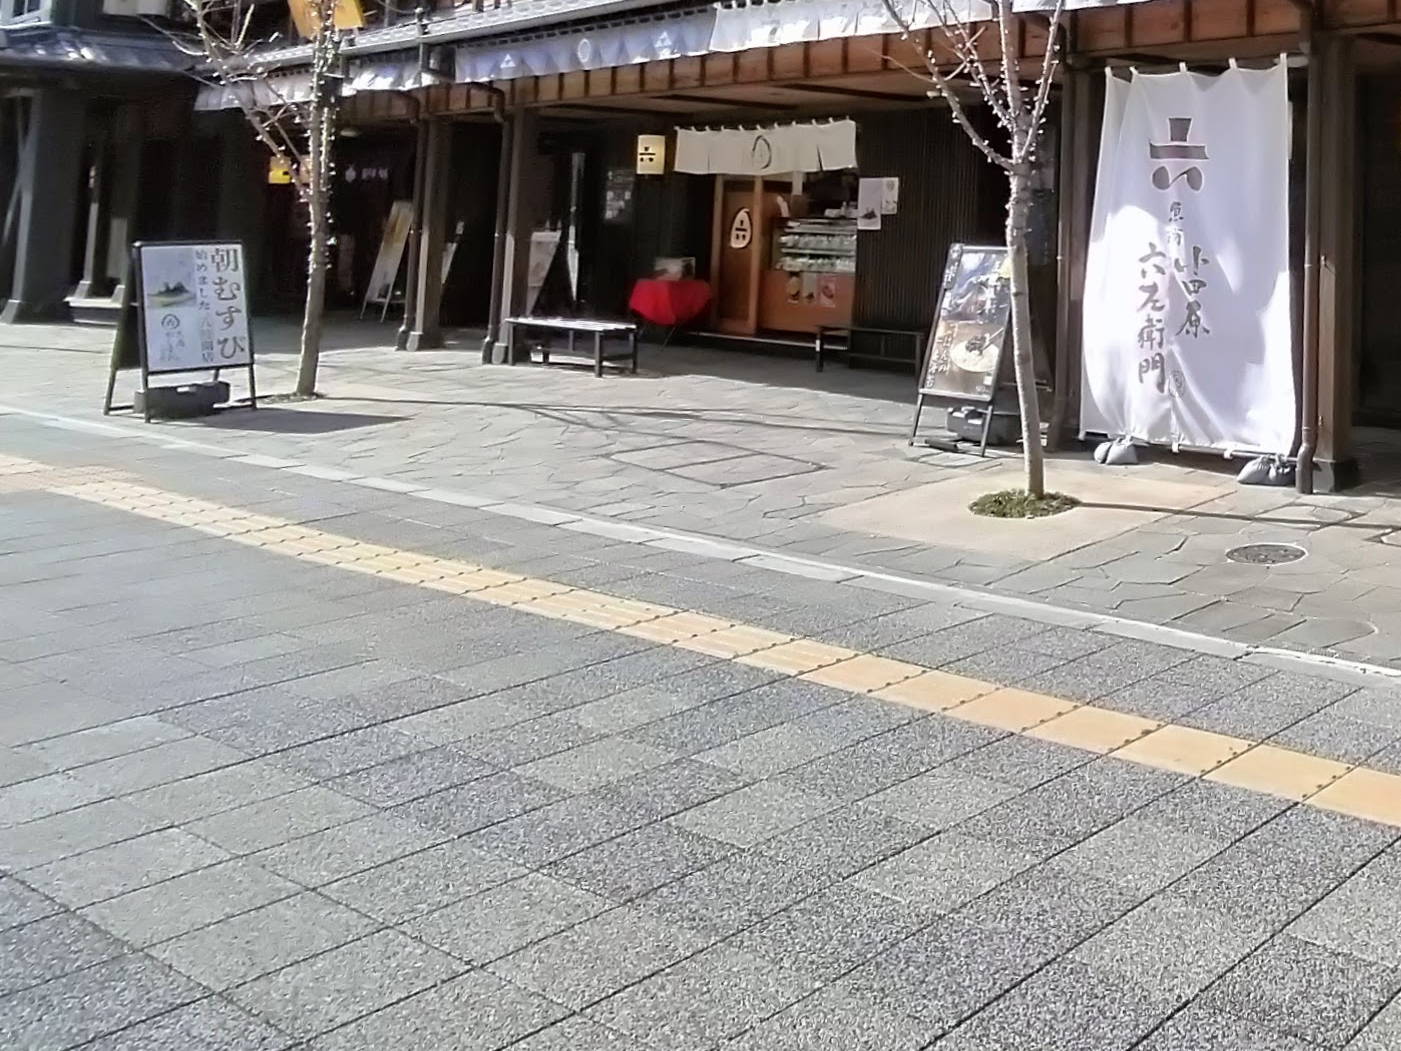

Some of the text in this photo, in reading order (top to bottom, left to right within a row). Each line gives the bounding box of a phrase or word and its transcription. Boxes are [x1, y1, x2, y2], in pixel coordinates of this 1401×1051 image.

[195, 249, 211, 311] 始めました
[210, 248, 246, 360] 朝むすび
[1136, 242, 1166, 394] 六左衛門
[1174, 245, 1211, 338] 小田原
